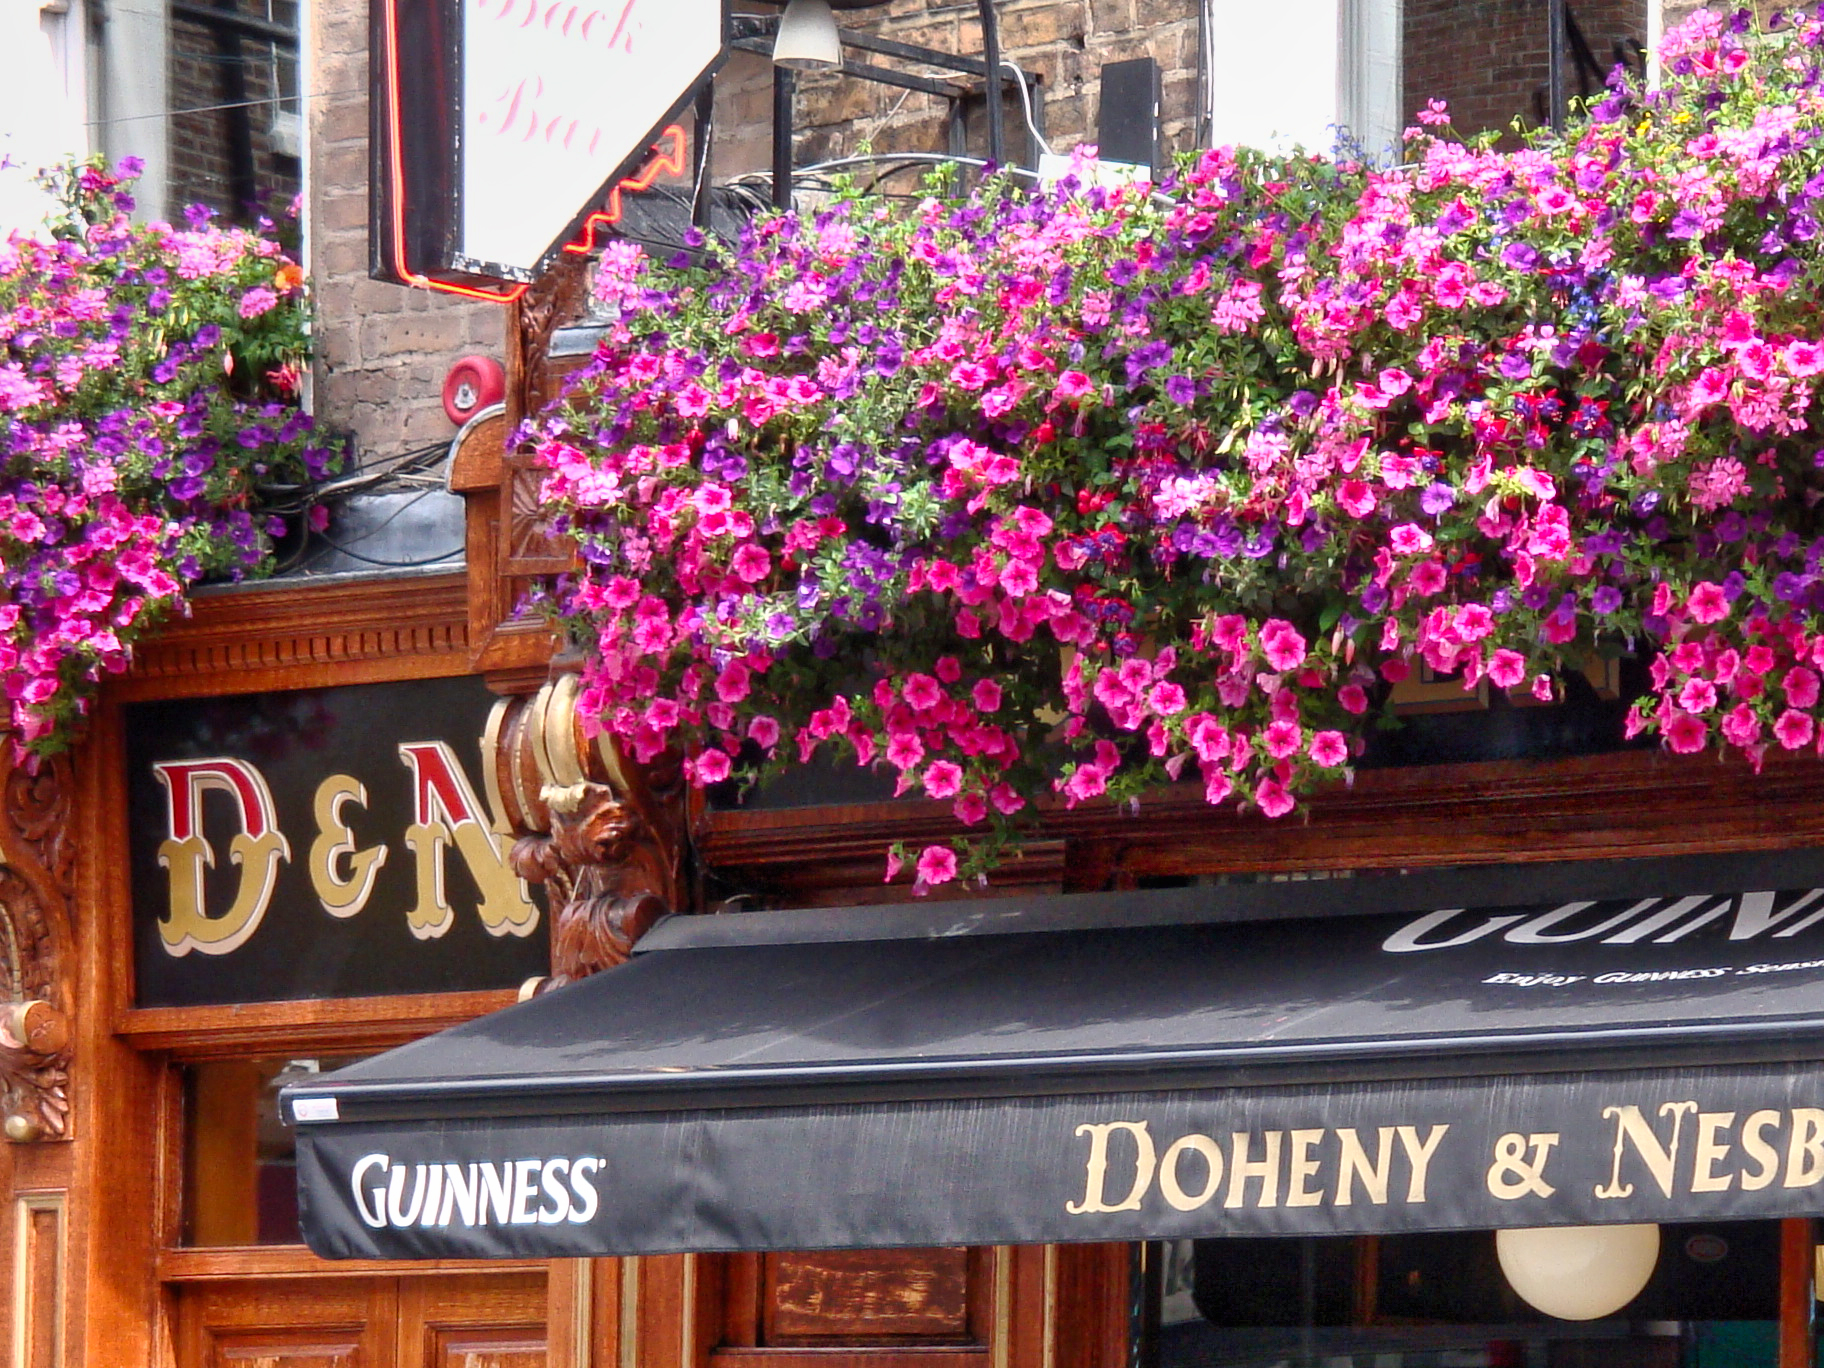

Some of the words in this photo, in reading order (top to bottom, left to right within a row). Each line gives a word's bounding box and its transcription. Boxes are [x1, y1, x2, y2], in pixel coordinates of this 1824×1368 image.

[152, 756, 291, 957] D
[309, 773, 388, 919] &
[399, 740, 540, 941] N
[1482, 970, 1587, 989] Enjoy
[351, 1153, 607, 1229] GUINNESS
[1066, 1120, 1449, 1215] DOHENY
[1487, 1132, 1560, 1200] &
